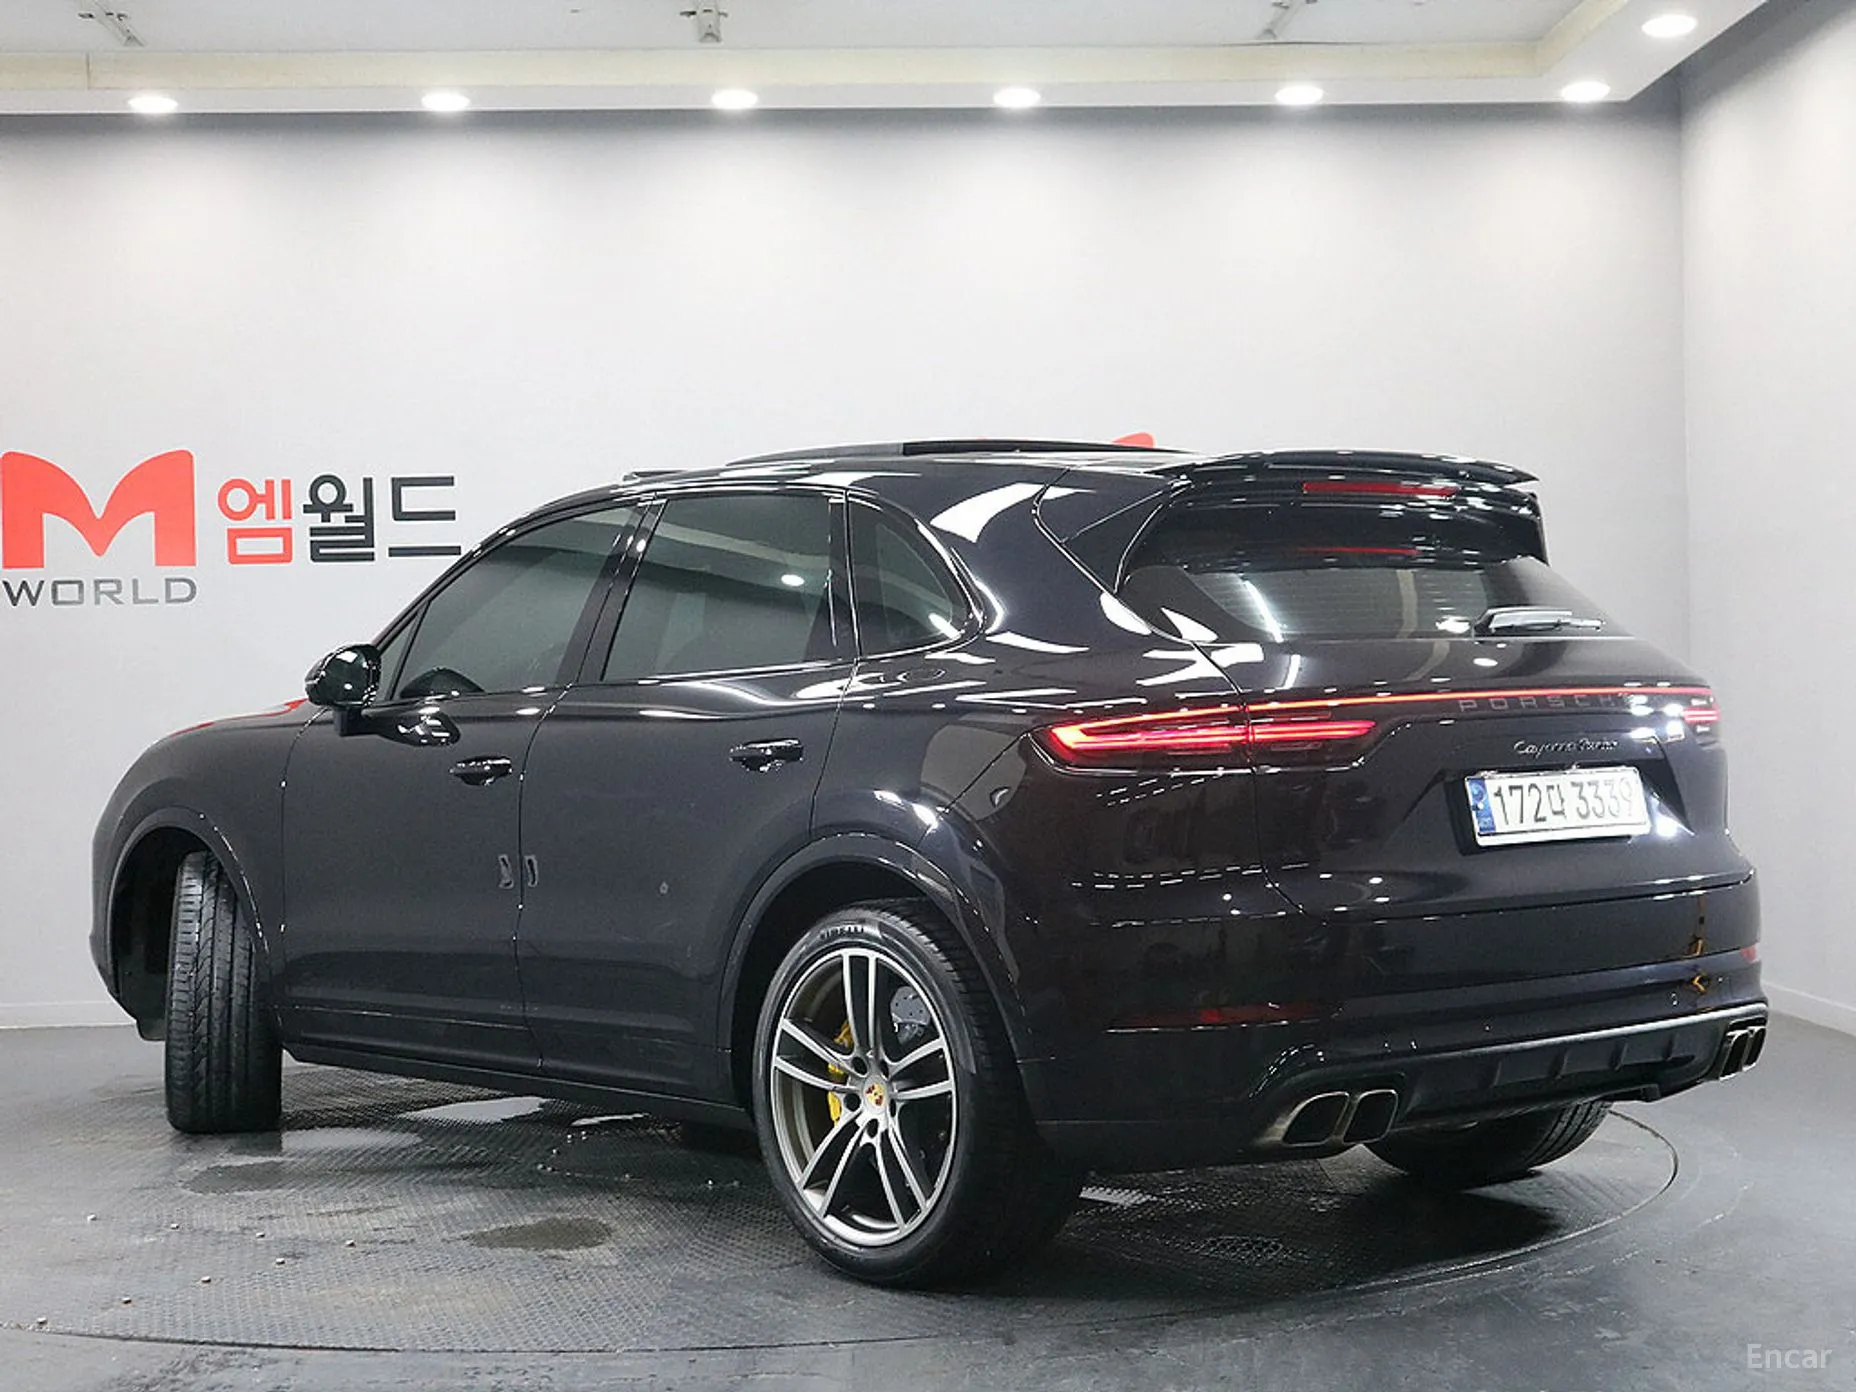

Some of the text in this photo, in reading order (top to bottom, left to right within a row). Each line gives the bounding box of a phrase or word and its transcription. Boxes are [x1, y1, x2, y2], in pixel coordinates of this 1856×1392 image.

[1, 449, 196, 569] M
[217, 474, 462, 564] 엠월드
[2, 577, 197, 607] WORLD
[1459, 693, 1642, 712] PORSCH
[1570, 777, 1633, 820] 3339
